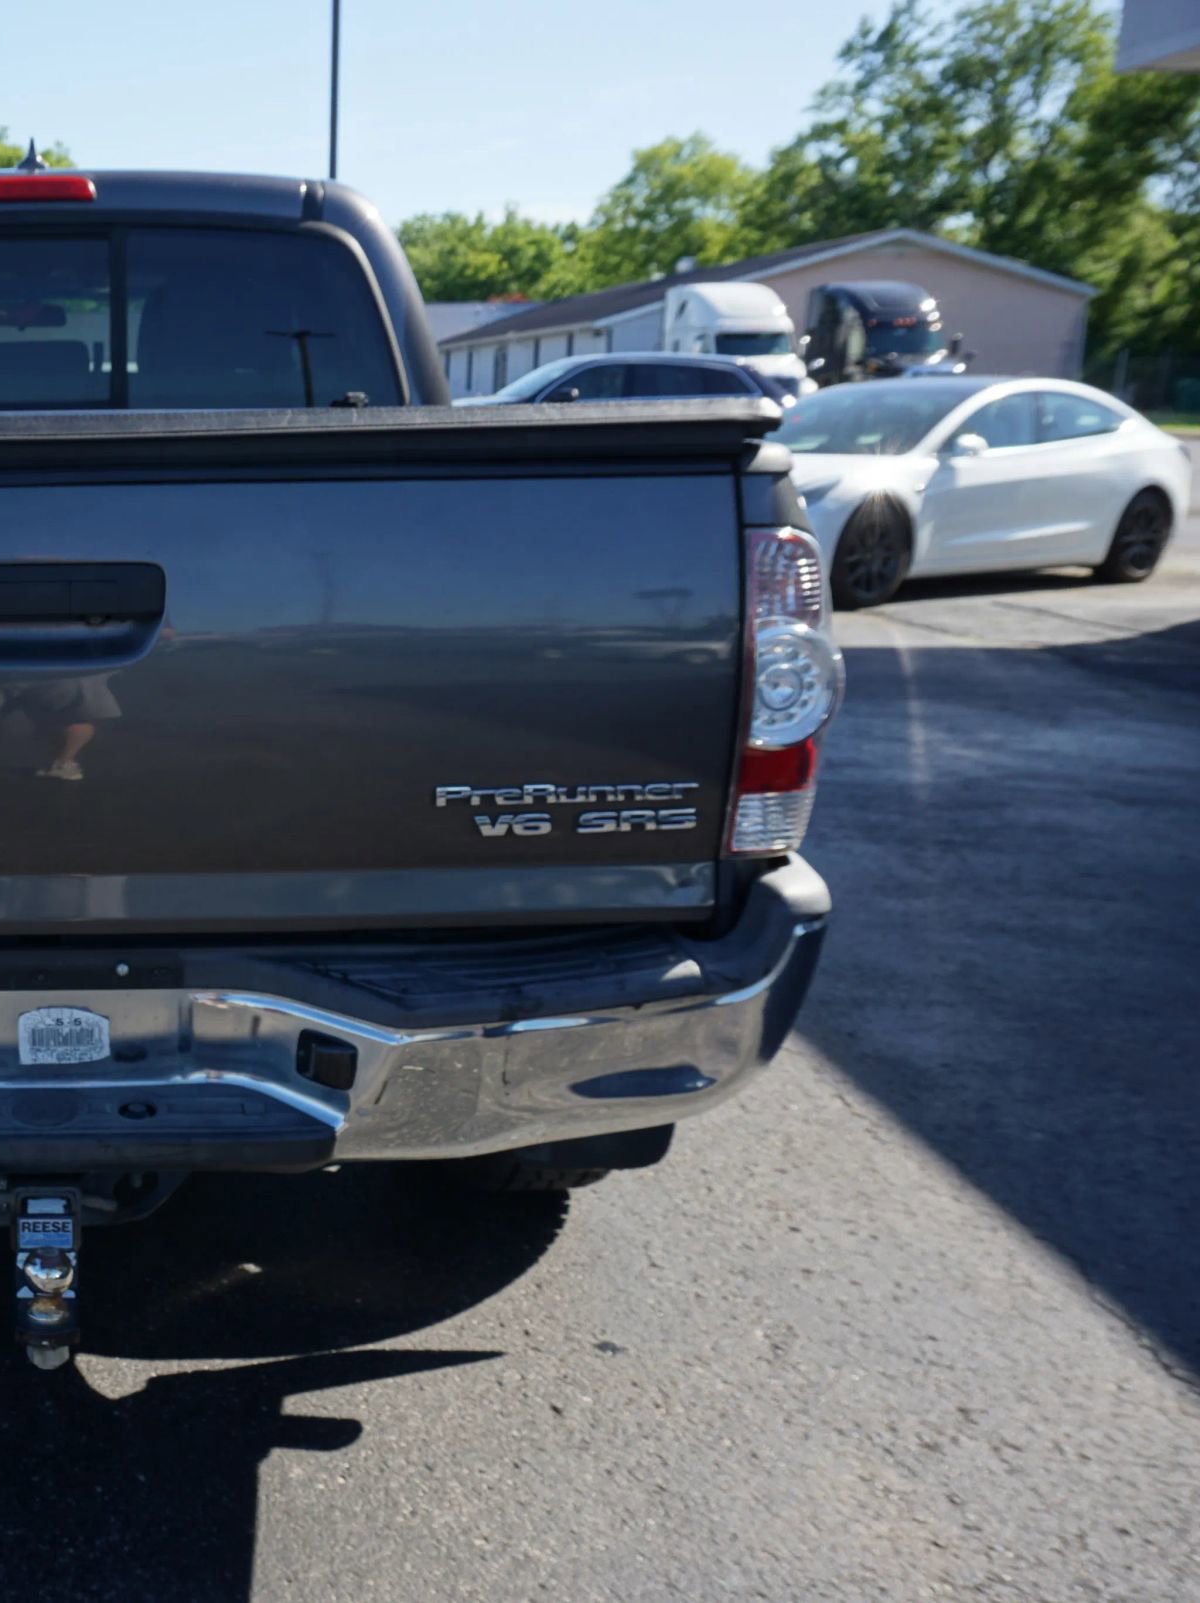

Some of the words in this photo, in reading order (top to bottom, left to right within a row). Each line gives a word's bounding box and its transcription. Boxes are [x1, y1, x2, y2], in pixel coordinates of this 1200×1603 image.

[436, 782, 699, 807] PreRunner
[474, 813, 552, 837] V6
[576, 807, 697, 833] SR5
[21, 1221, 71, 1233] REESE
